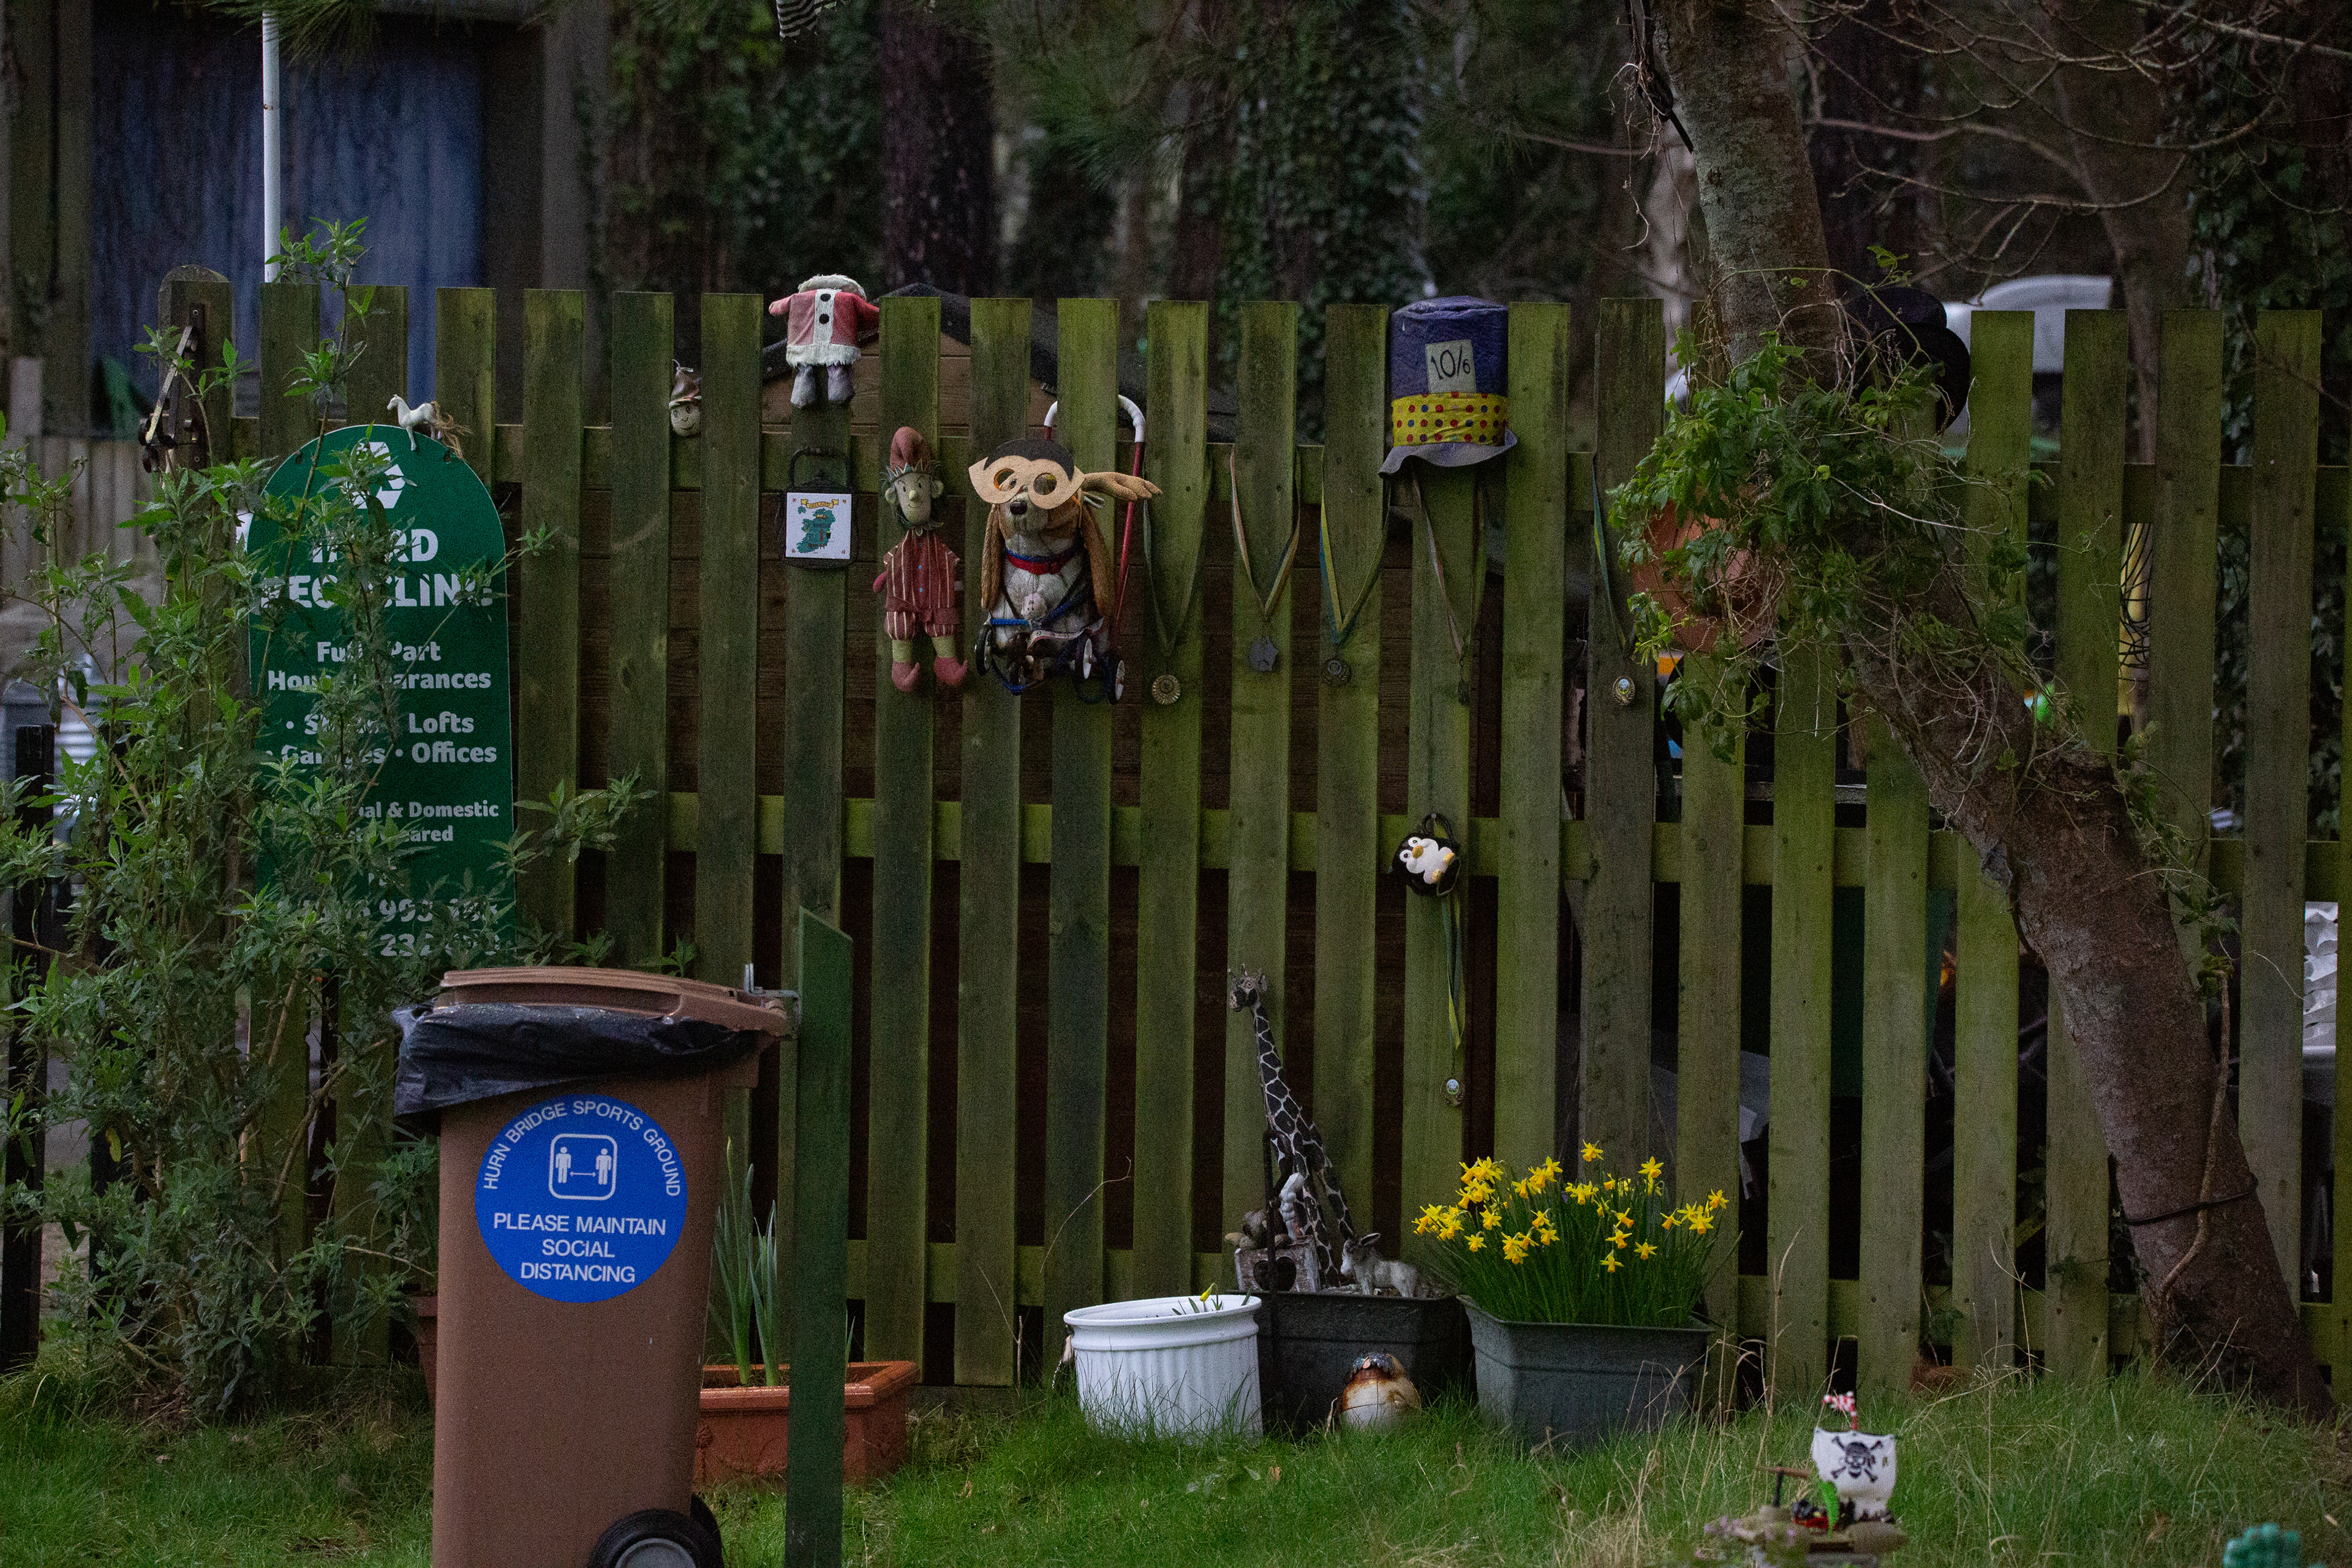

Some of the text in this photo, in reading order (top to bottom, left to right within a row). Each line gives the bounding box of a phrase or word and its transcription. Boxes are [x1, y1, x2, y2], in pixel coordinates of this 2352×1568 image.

[1431, 344, 1471, 380] 10/6
[409, 711, 474, 734] Lofts
[412, 741, 497, 763] Offices
[386, 801, 403, 818] &
[409, 799, 499, 818] Domestic
[483, 1100, 681, 1197] HURN BRIDGE SPORTS GROUND
[493, 1212, 666, 1235] PLEASE MAINTAIN
[541, 1238, 616, 1258] SOCIAL
[521, 1262, 636, 1283] DISTANCING
